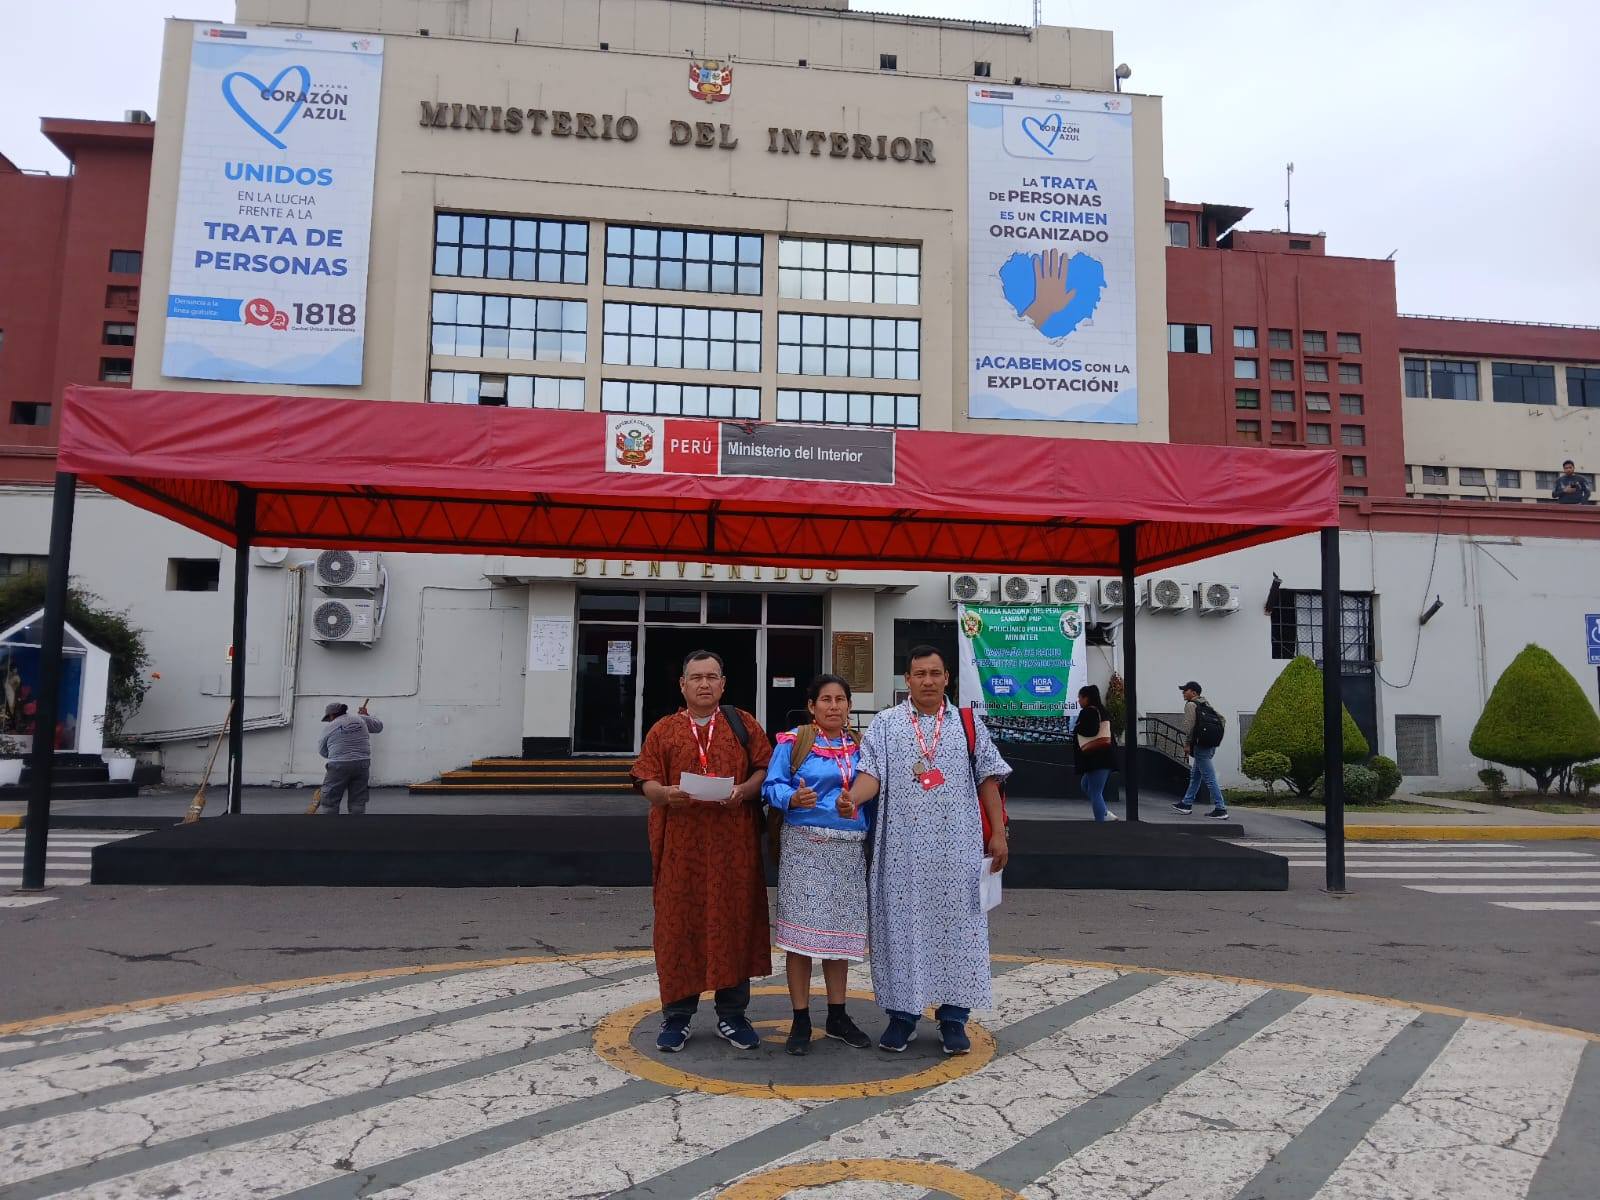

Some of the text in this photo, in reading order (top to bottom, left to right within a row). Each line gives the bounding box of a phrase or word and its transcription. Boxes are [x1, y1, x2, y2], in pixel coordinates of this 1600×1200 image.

[260, 89, 348, 106] CORAZÓN
[302, 106, 346, 121] AZUL
[420, 100, 936, 164] MINISTERIO DEL INTERIOR
[1059, 133, 1080, 142] AZUL
[224, 162, 333, 186] UNIDOS
[1023, 176, 1098, 191] LA TRATA
[238, 191, 316, 206] EN LA LUCHA
[989, 190, 1102, 207] DE PERSONAS
[239, 206, 313, 220] FRENTE A LA
[1000, 210, 1107, 226] ES UN CRIMEN
[204, 221, 343, 247] TRATA DE
[989, 225, 1109, 243] ORGANIZADO
[194, 250, 348, 277] PERSONAS
[293, 303, 356, 326] 1818
[976, 355, 1130, 374] ¡ACABEMOS CON LA
[987, 375, 1119, 393] EXPLOTACIÓN!
[671, 437, 712, 455] PERÚ
[728, 441, 863, 463] Ministerio del Interior
[573, 558, 840, 582] BIENVENIDOS
[991, 678, 1014, 686] FECHA
[1032, 678, 1053, 686] HORA
[970, 700, 1001, 710] Dirigido
